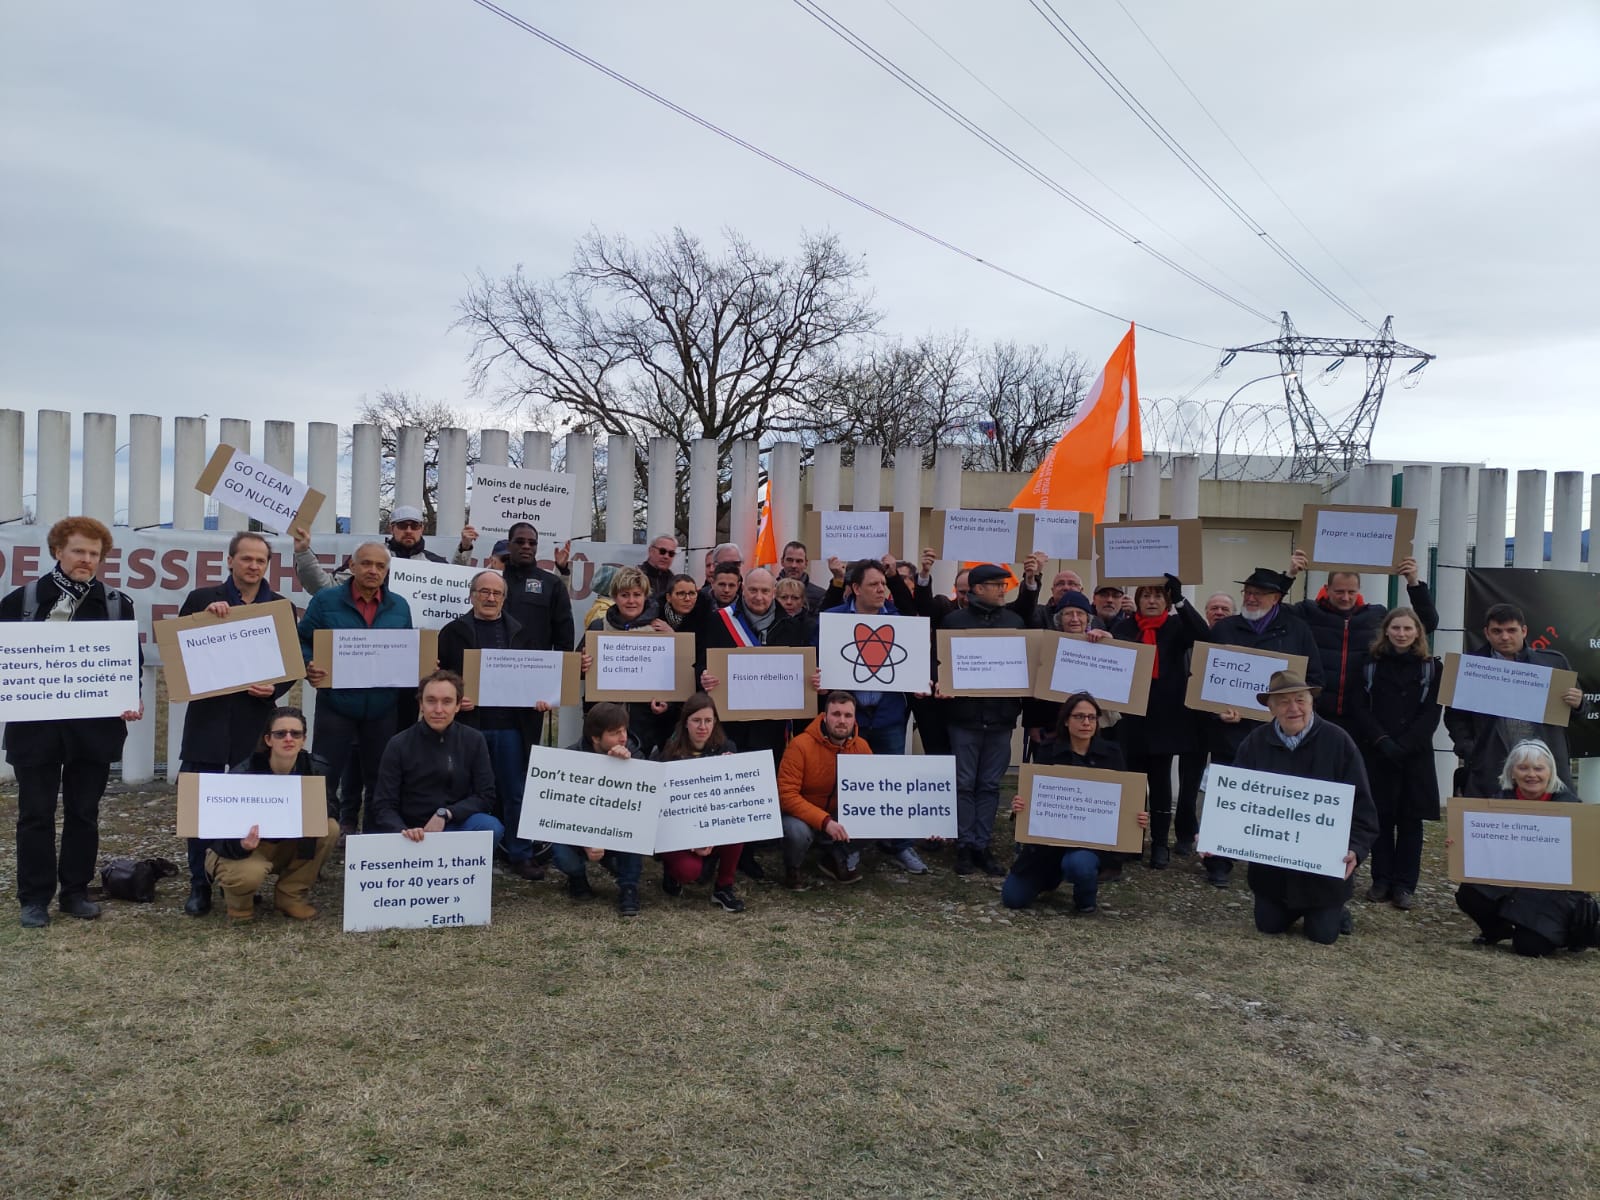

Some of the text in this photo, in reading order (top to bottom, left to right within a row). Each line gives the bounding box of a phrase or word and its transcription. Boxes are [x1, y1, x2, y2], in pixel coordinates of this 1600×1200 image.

[234, 461, 293, 496] GO CLEAN
[477, 477, 570, 495] Moins de nucléaire,
[224, 478, 299, 521] GO NUCLEAR
[517, 496, 537, 506] plus
[539, 498, 551, 507] de
[501, 510, 541, 521] charbon
[1321, 529, 1348, 538] Propre
[1356, 531, 1393, 540] nucléaire
[0, 545, 40, 587] E
[394, 571, 443, 586] Moins de
[440, 594, 461, 603] plus
[186, 625, 271, 648] Nuclear is Green
[1546, 626, 1559, 639] ?
[69, 644, 75, 653] 1
[79, 644, 90, 653] et
[93, 645, 111, 653] ses
[616, 643, 651, 651] détruisez
[652, 645, 666, 653] pas
[46, 659, 77, 669] héros
[81, 658, 95, 668] du
[98, 658, 132, 667] climat
[1212, 658, 1251, 672] E=mc2
[1465, 662, 1502, 673] Défendons
[2, 673, 133, 687] avant que la société ne
[733, 672, 794, 681] Fission rébellion
[1210, 674, 1226, 686] for
[1464, 671, 1500, 681] défendons
[1512, 678, 1544, 688] centrales
[0, 689, 109, 702] se soucie du climat
[530, 766, 657, 794] Don’t tear down the
[669, 768, 760, 788] Fessenheim 1, merci
[670, 784, 756, 803] pour ces 40 années
[841, 778, 952, 796] Save the planet
[1039, 783, 1075, 792] Fessenheim
[1217, 775, 1340, 806] Ne détruisez pas
[240, 796, 284, 804] REBELLION
[539, 788, 642, 812] climate citadels!
[1093, 799, 1117, 807] années
[659, 804, 708, 818] ’électricité
[710, 798, 765, 811] bas-carbone
[842, 802, 951, 820] Save the plants
[1087, 806, 1114, 815] carbone
[1216, 796, 1335, 827] les citadelles du
[699, 812, 773, 829] La Planète Terre
[1044, 810, 1068, 819] Planète
[1070, 813, 1087, 821] Terre
[539, 818, 633, 839] #climatevandalism
[1243, 823, 1300, 843] climat !
[1470, 820, 1540, 832] Sauvez le climat,
[1471, 832, 1560, 844] soutenez le nucléaire
[360, 858, 434, 871] Fessenheim
[437, 858, 448, 869] 1,
[452, 856, 487, 867] thank
[1216, 844, 1322, 870] #vandalismeclimatique
[360, 874, 475, 891] you for 40 years of
[373, 896, 461, 908] clean power »
[432, 913, 464, 925] Earth
